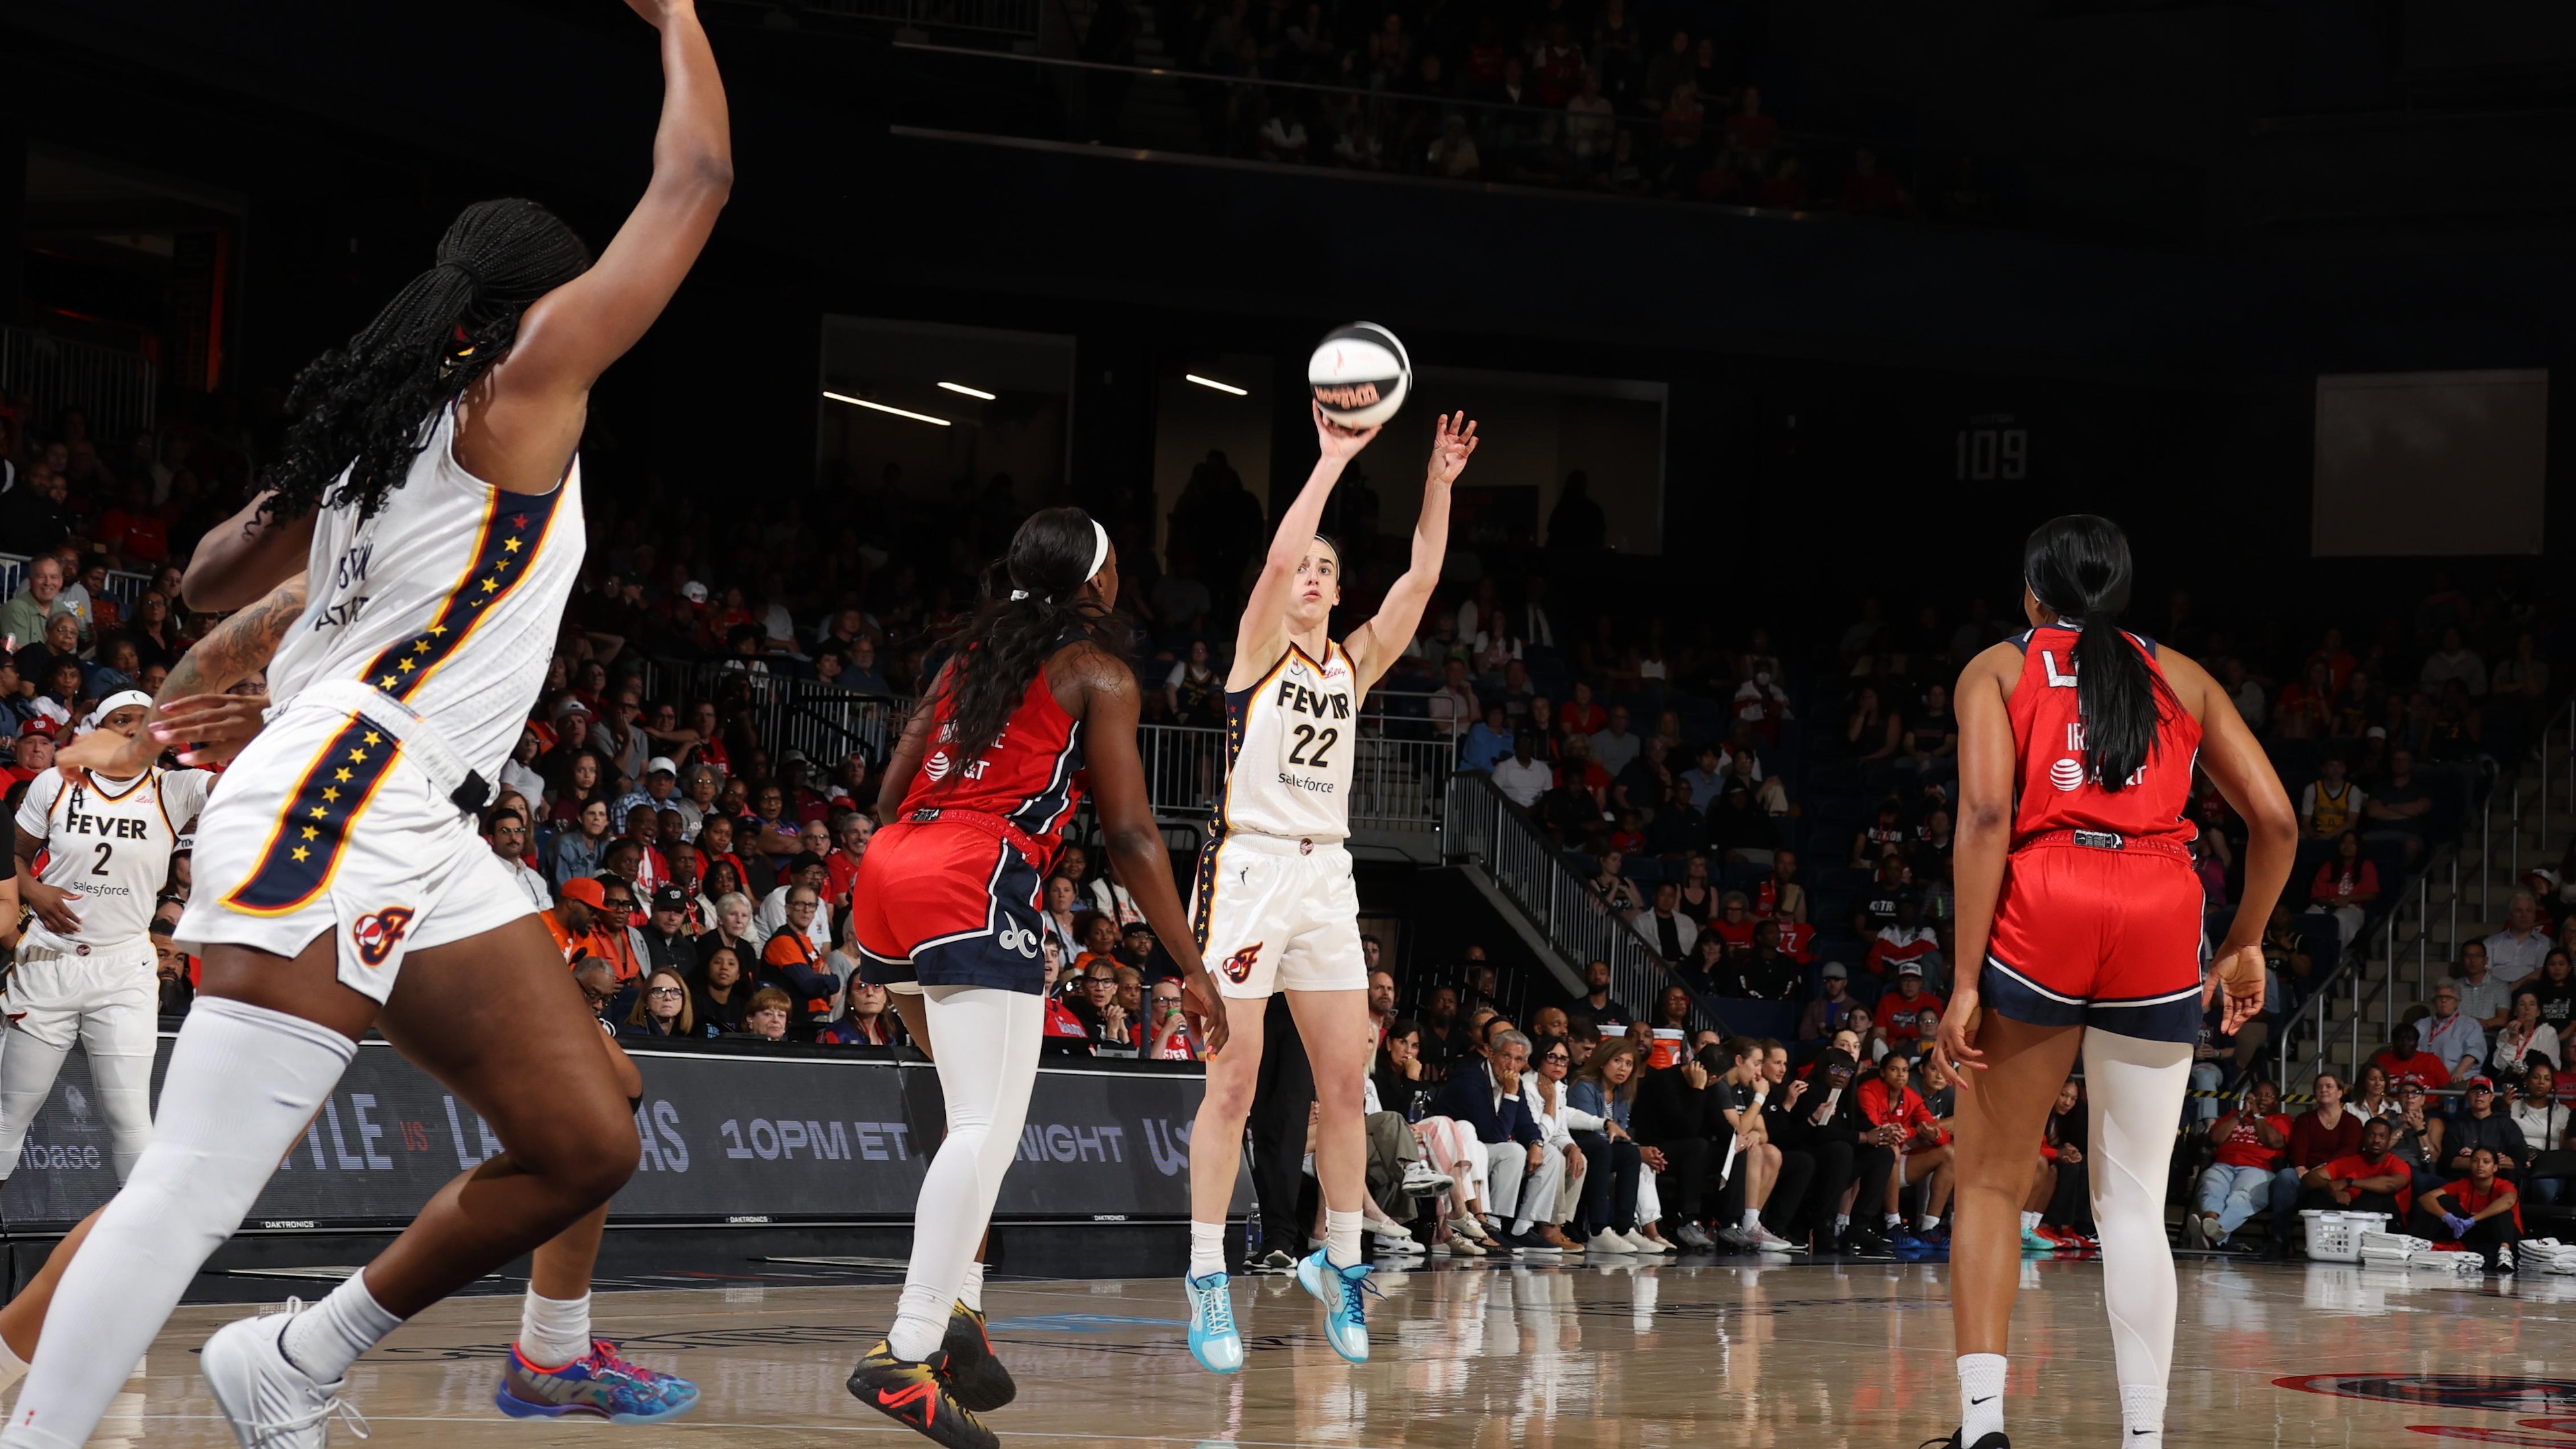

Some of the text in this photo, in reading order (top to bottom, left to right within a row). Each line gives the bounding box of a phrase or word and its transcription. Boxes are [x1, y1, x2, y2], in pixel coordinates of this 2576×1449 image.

[1955, 429, 2028, 481] 109
[1325, 667, 1347, 679] Lilly
[1289, 724, 1338, 768] 22
[135, 796, 154, 805] Lilly
[66, 814, 148, 841] FEVER
[91, 842, 113, 876] 2
[73, 881, 129, 897] salesforce
[635, 1100, 690, 1173] AS
[720, 1118, 852, 1161] 10PM
[854, 1122, 908, 1161] ET
[1015, 1124, 1123, 1163] NIGHT
[16, 1135, 101, 1169] nbase
[265, 1220, 315, 1229] DAKTRONICS
[729, 1216, 769, 1224] DAKTRONICS
